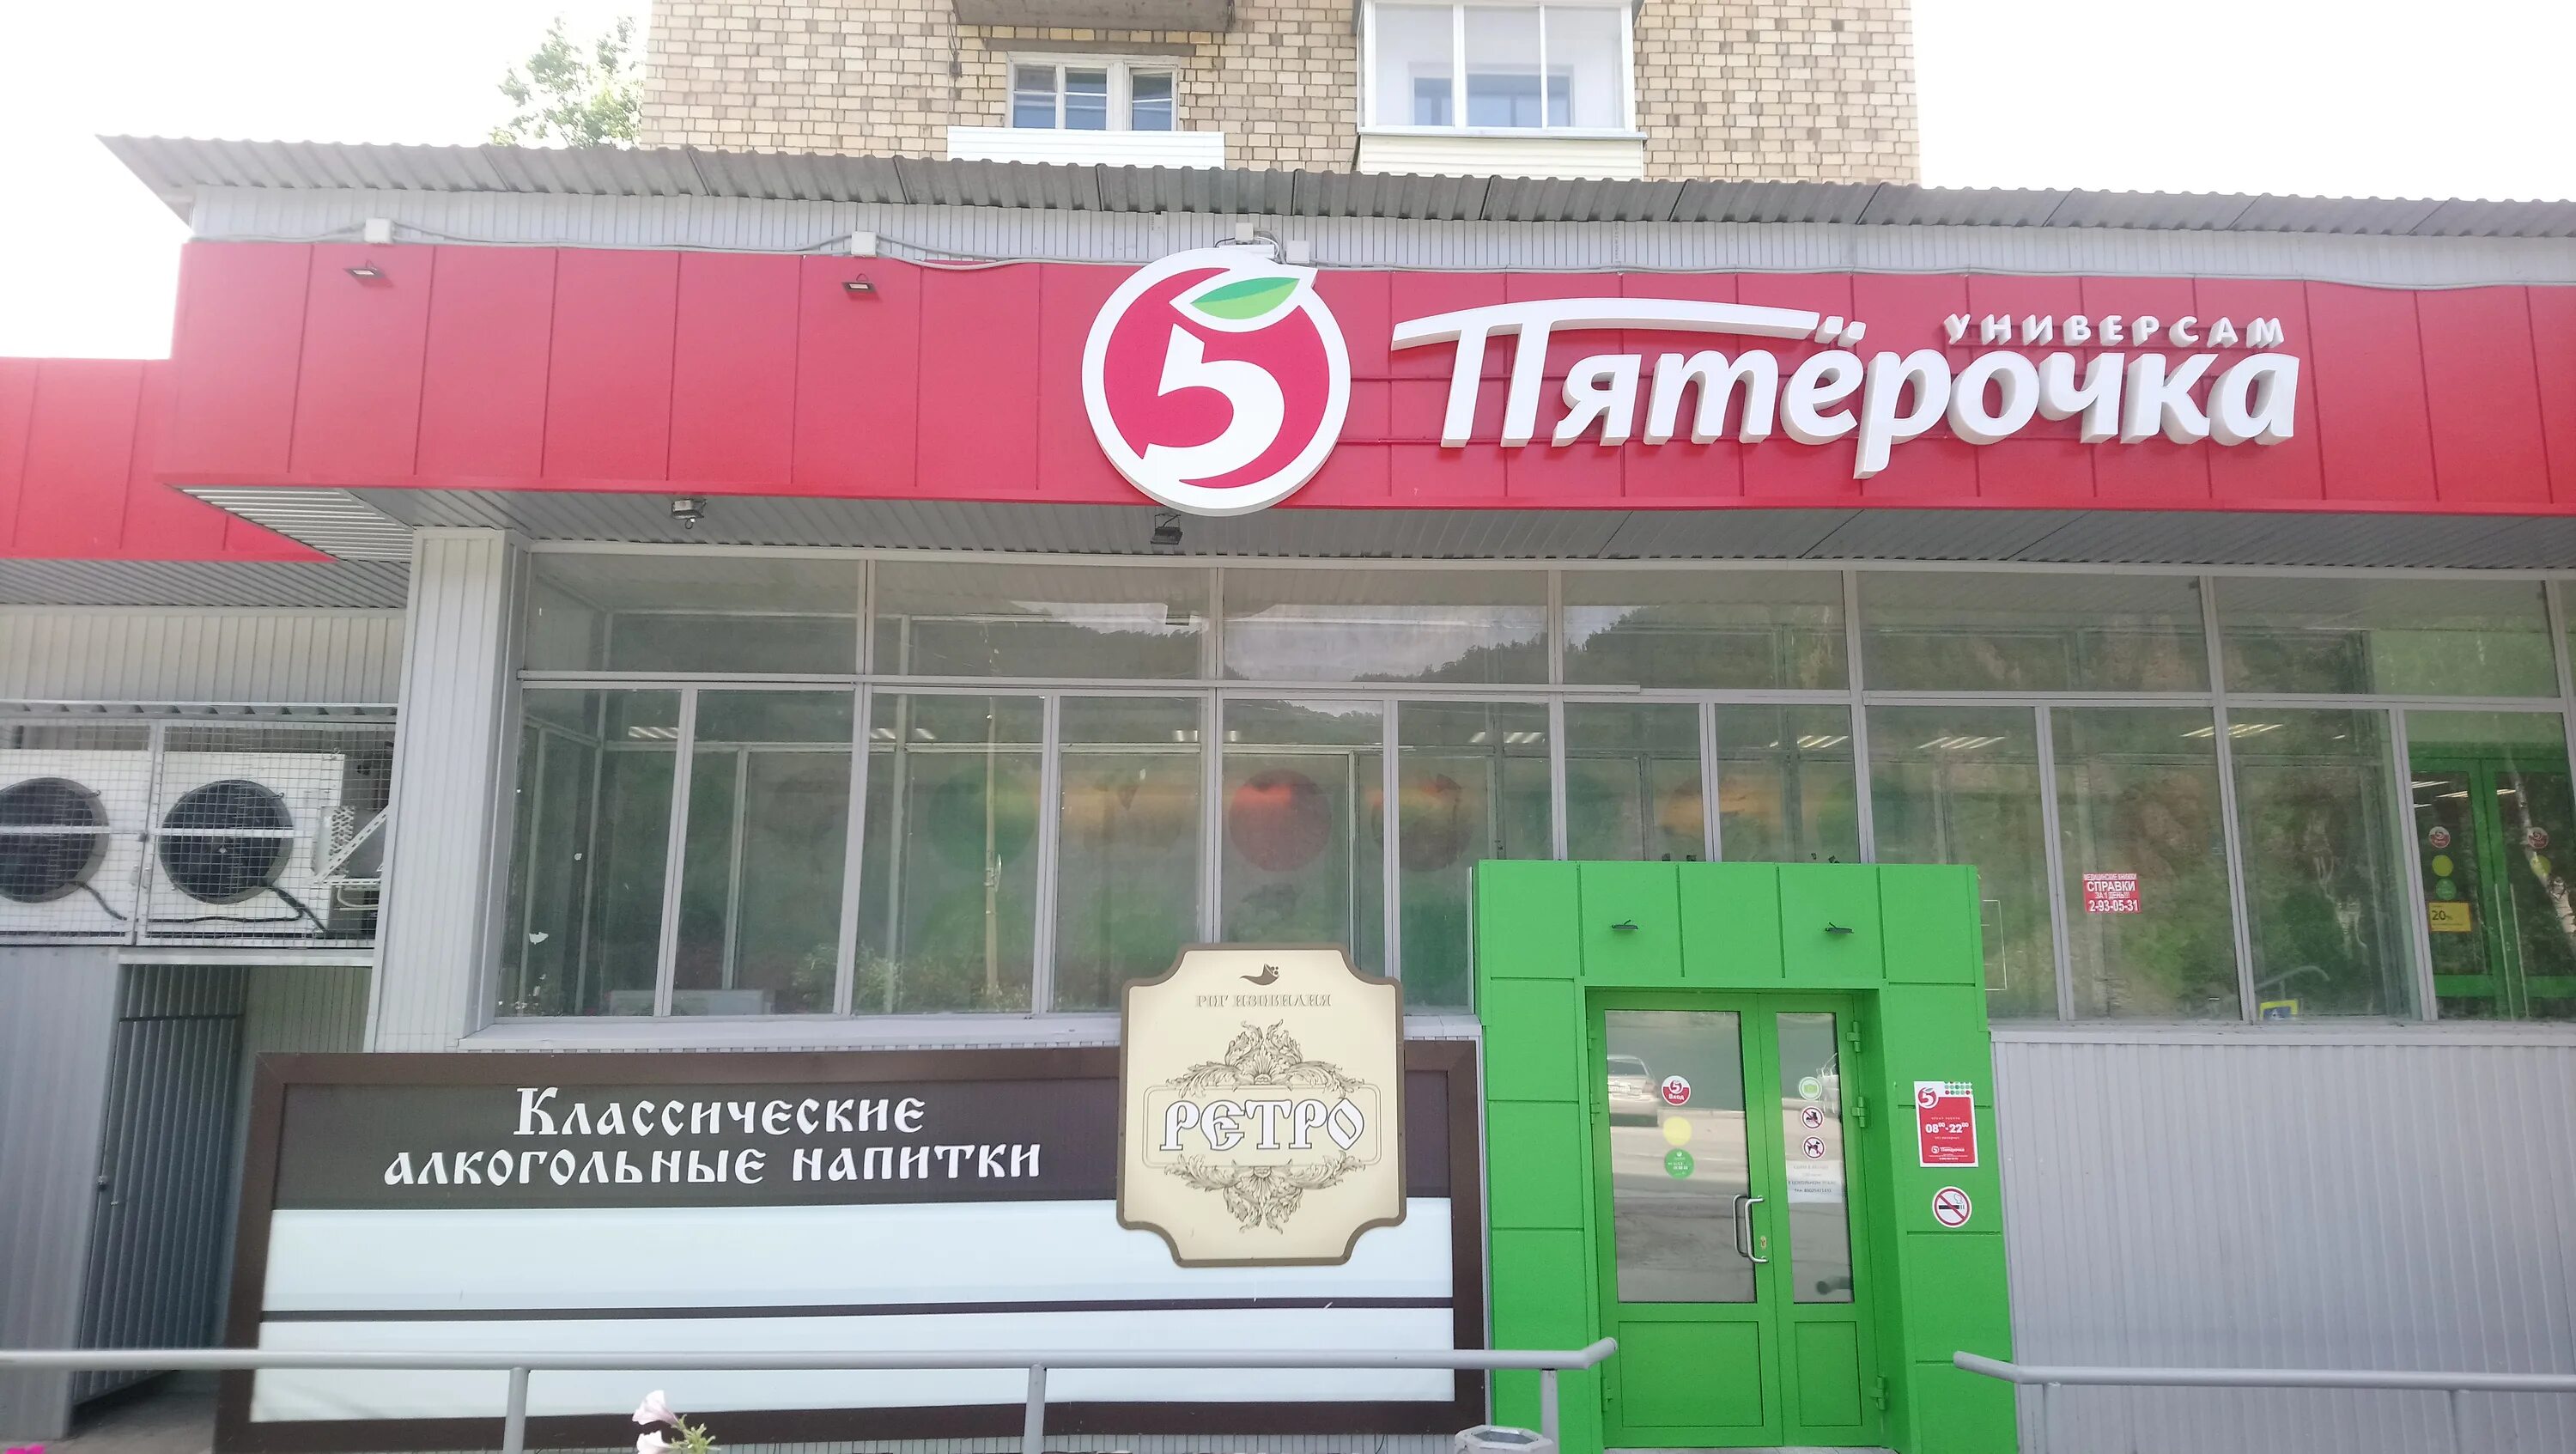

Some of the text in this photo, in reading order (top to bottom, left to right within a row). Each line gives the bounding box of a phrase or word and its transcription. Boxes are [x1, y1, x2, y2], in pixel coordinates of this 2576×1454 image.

[1941, 312, 2285, 348] УНИВЕРСАМ
[1392, 297, 2300, 479] Пятёрочка
[2087, 881, 2136, 891] СПРАВКИ
[2089, 900, 2139, 911] 2-93-05-31
[1159, 1098, 1365, 1151] РЕТРО
